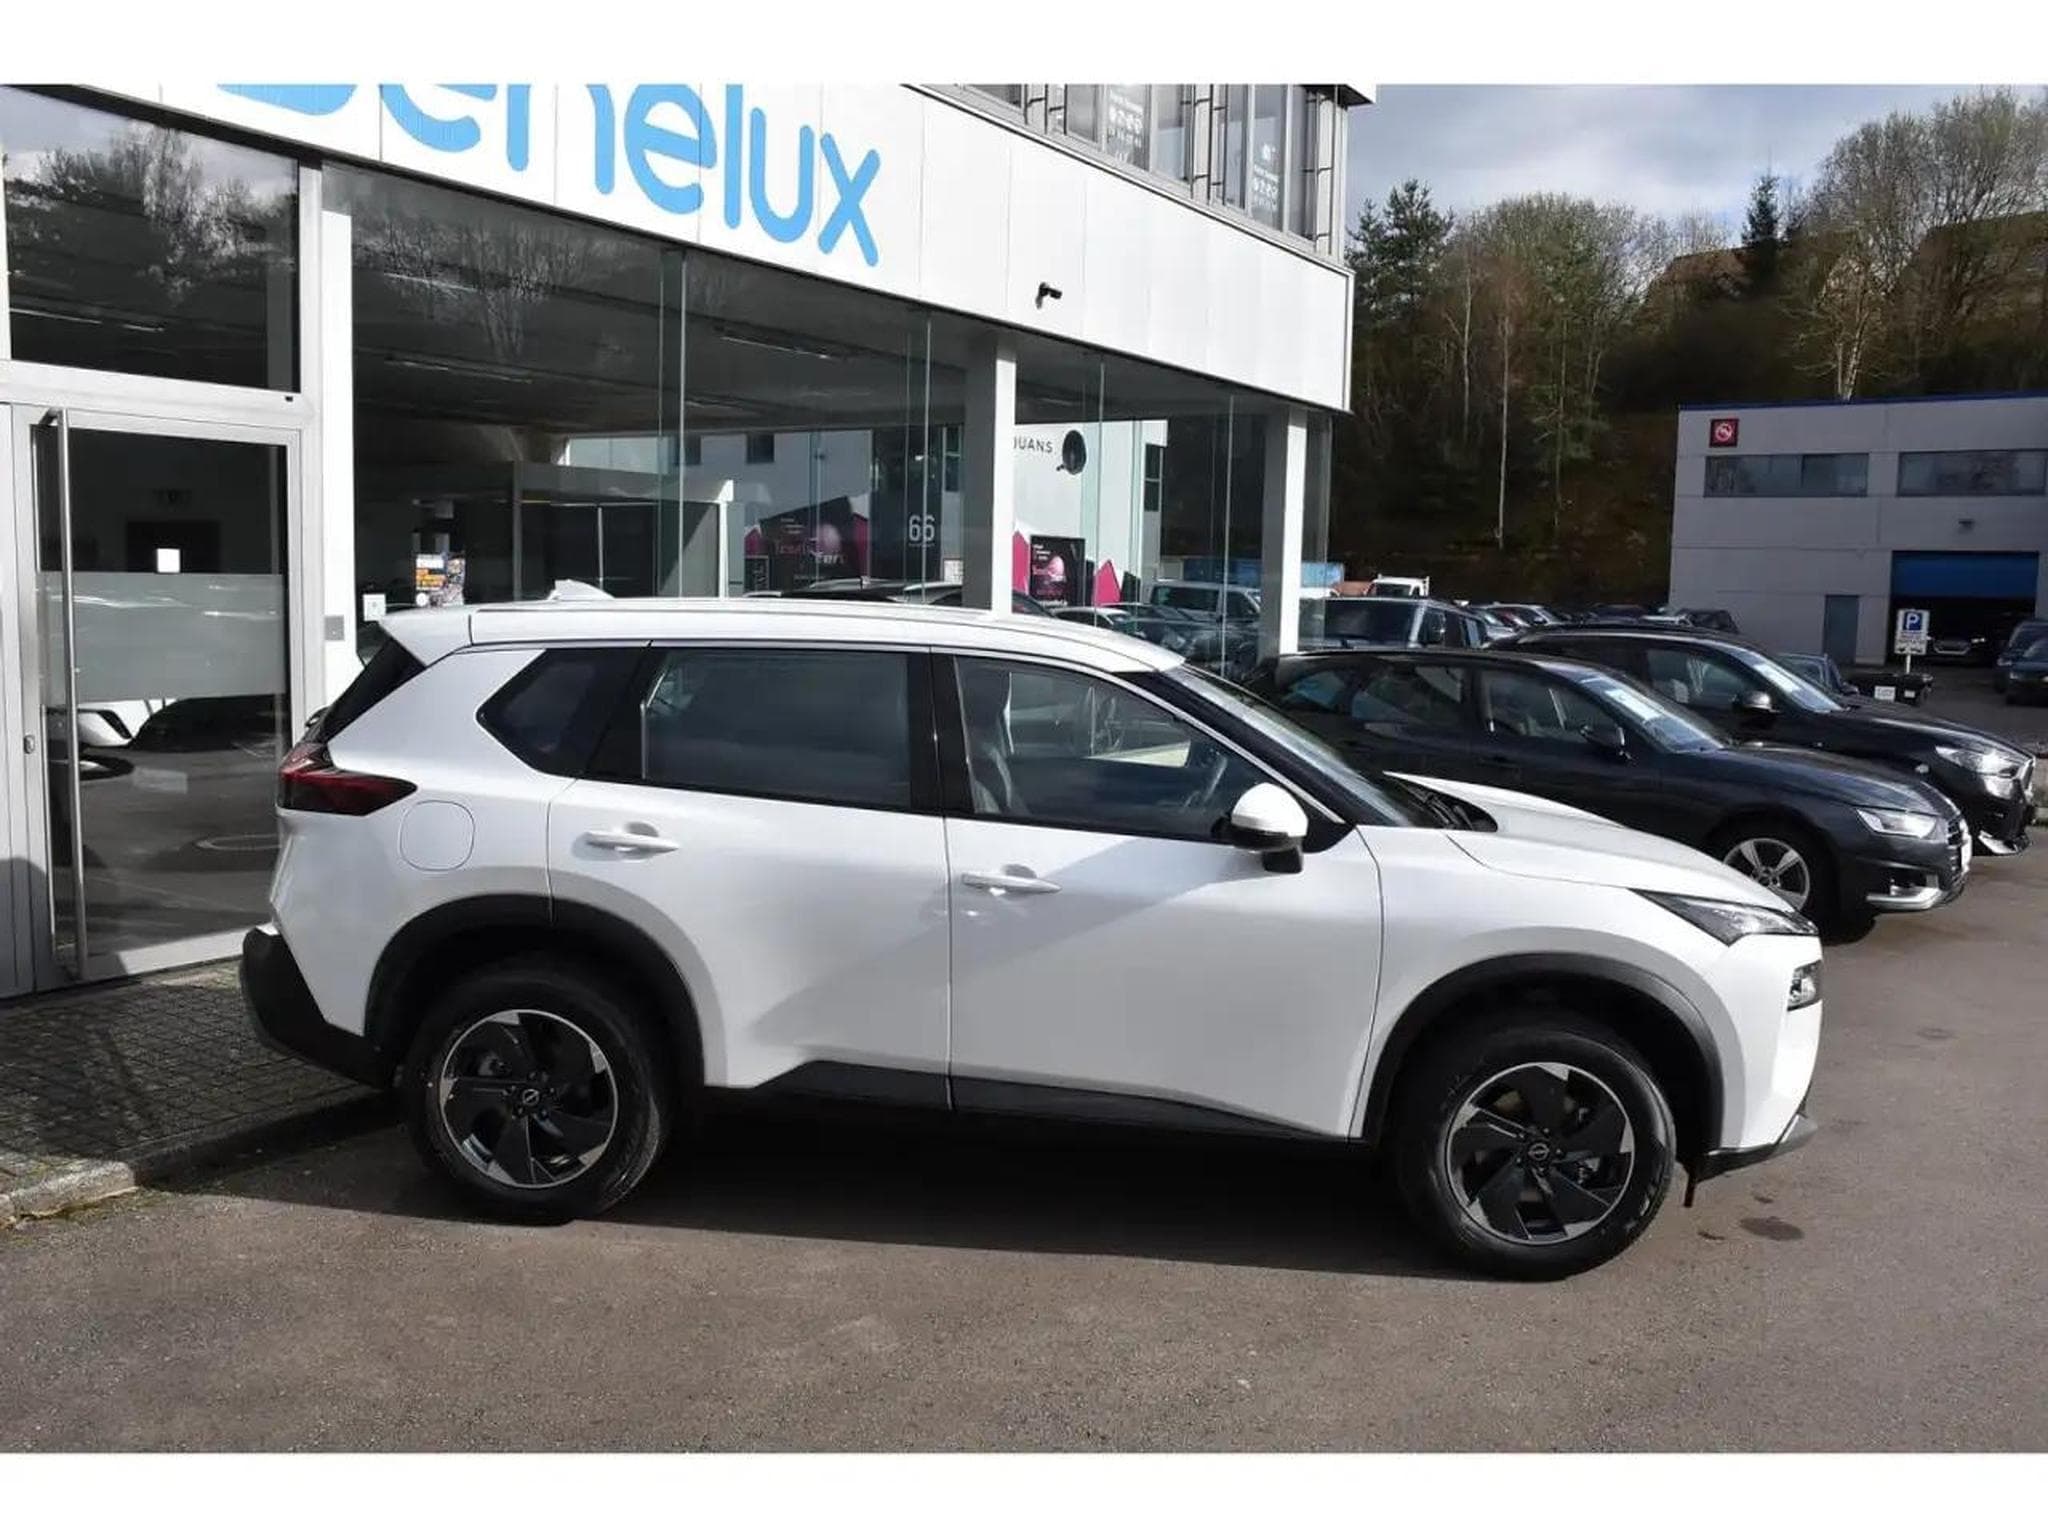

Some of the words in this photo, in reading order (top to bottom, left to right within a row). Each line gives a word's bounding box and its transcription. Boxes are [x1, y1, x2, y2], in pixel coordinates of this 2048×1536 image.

[213, 84, 881, 266] nelux
[909, 514, 935, 542] 66
[1906, 613, 1920, 630] P
